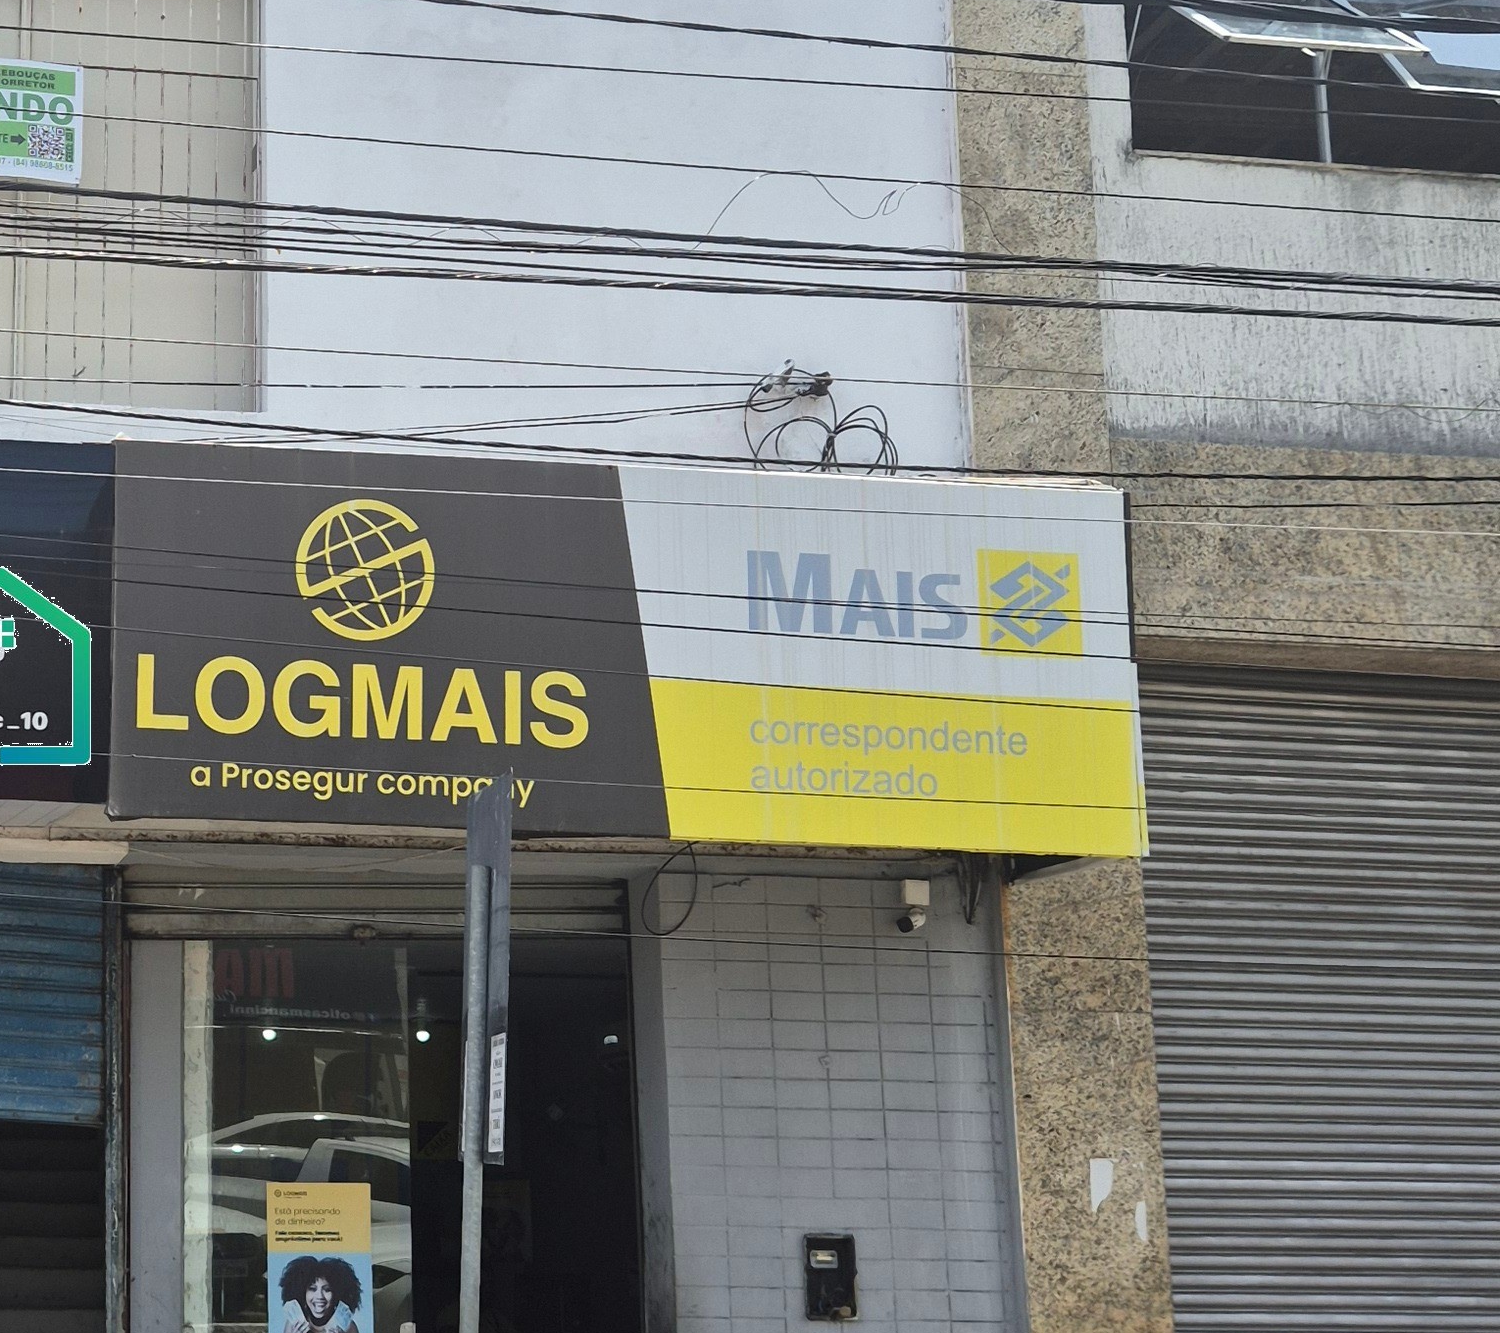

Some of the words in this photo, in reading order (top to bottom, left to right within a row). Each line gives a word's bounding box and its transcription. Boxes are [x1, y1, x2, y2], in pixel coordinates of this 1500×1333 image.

[746, 550, 969, 641] MAIS
[136, 654, 590, 750] LOGMAIS
[750, 718, 1028, 757] correspondente
[190, 765, 211, 788] a
[221, 763, 369, 801] Prosegur
[376, 772, 535, 809] compy
[750, 761, 938, 797] autorizado
[275, 1218, 286, 1226] de
[288, 1218, 326, 1226] dinheiro?
[293, 1207, 341, 1217] precisando
